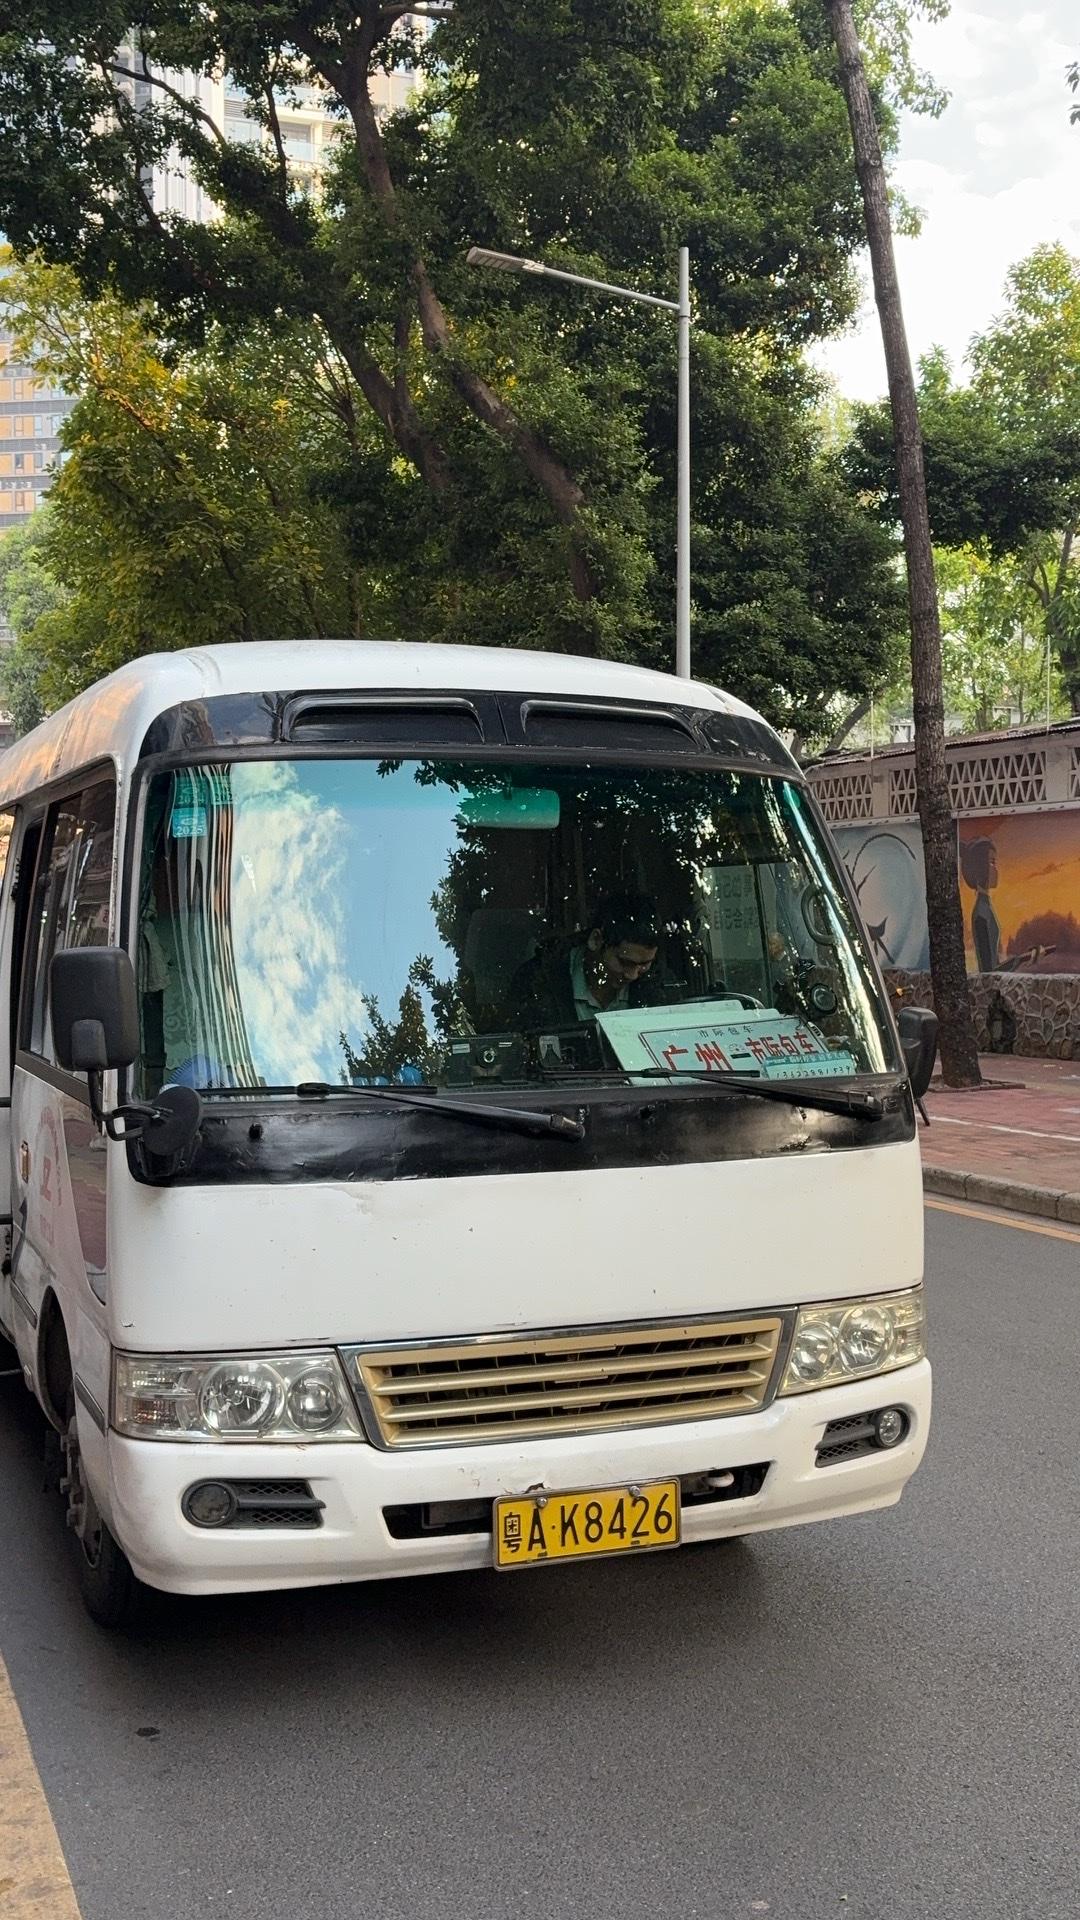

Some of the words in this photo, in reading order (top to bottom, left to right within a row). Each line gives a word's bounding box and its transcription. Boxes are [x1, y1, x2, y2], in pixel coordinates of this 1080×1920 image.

[176, 825, 204, 835] 2025
[661, 1041, 734, 1072] 广州
[744, 1031, 819, 1065] 市际包车
